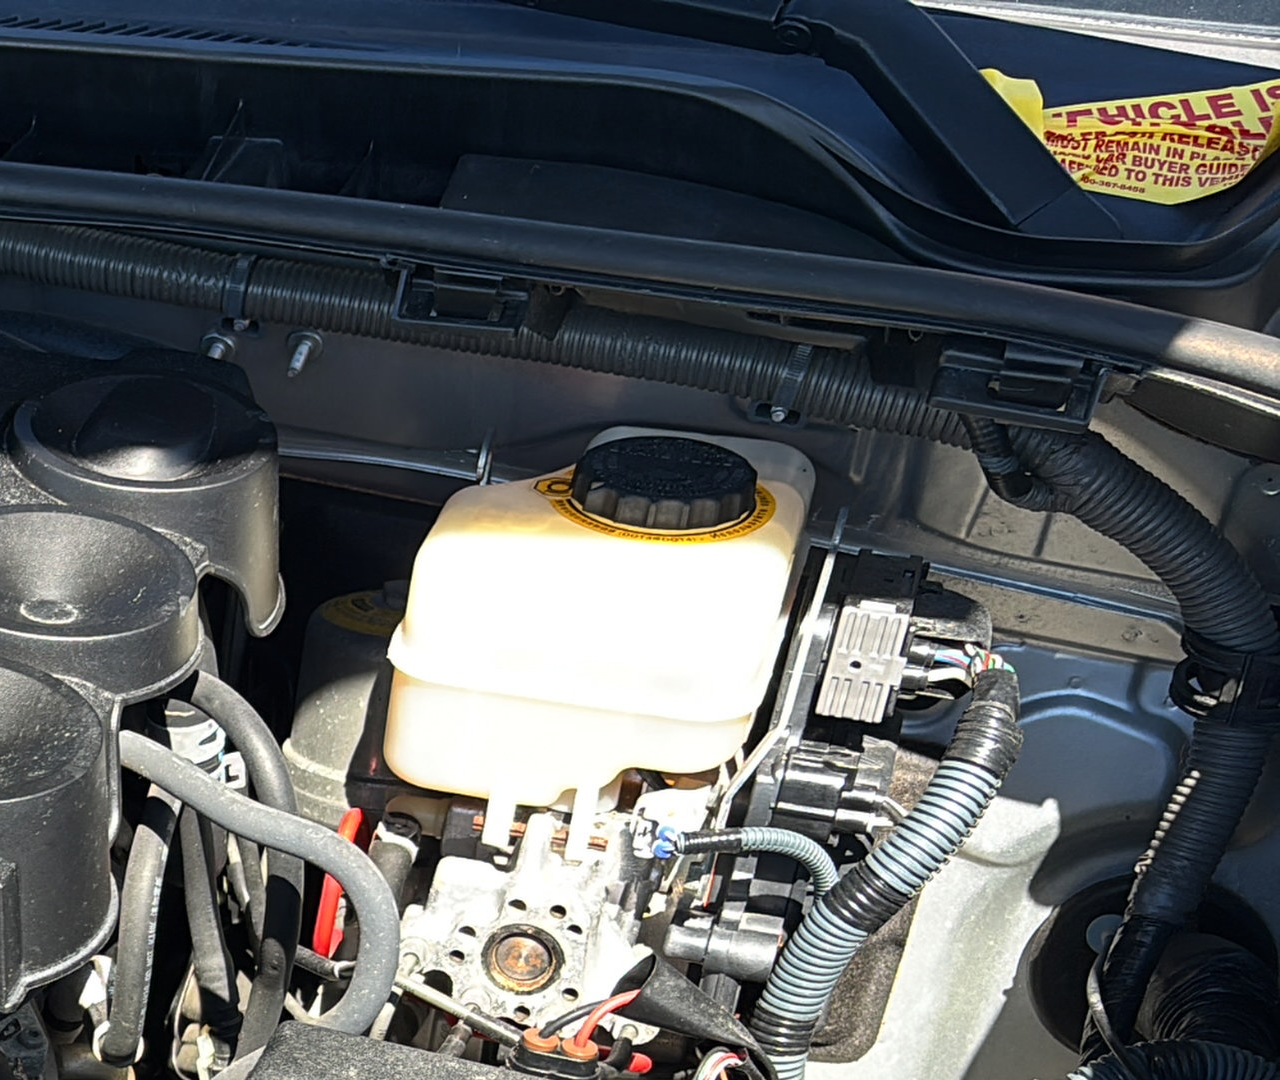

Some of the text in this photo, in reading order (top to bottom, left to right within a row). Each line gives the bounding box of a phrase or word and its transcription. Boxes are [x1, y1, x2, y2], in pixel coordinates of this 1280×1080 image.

[1052, 93, 1243, 128] EHICLE
[1093, 139, 1160, 156] REMAIN
[1166, 146, 1185, 160] IN
[1131, 155, 1191, 175] BUYER
[1124, 168, 1147, 182] TO
[1152, 173, 1192, 187] THIS
